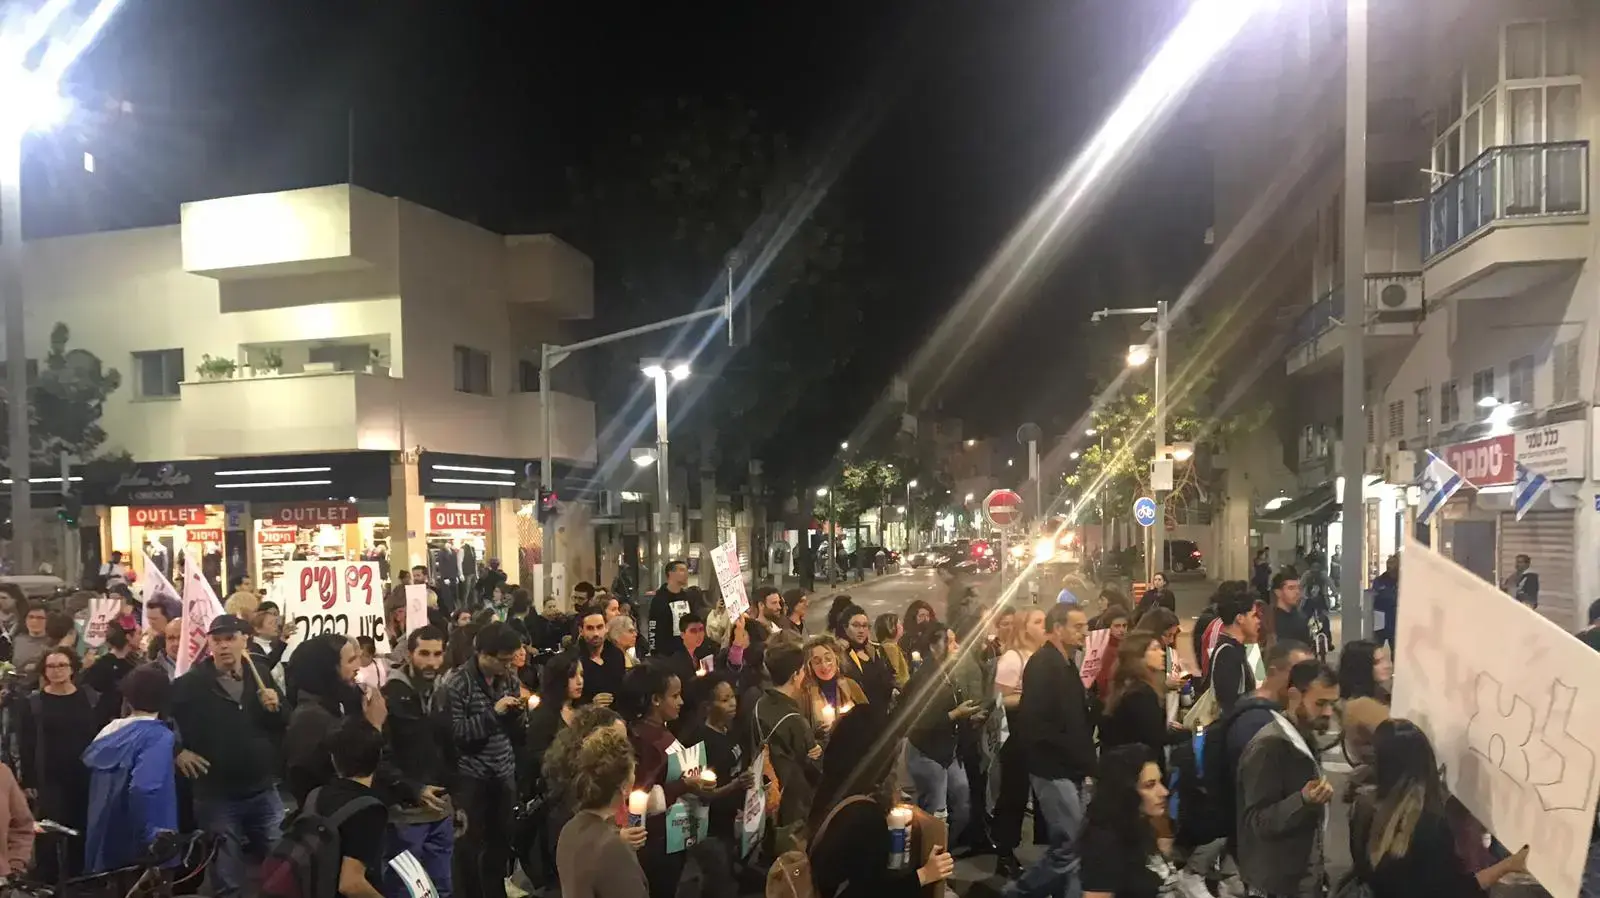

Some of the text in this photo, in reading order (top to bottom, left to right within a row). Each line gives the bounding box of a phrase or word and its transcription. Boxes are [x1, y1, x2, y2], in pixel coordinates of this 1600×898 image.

[1451, 443, 1503, 478] טמבור
[136, 508, 198, 522] OUTLET
[281, 507, 349, 520] OUTLET
[436, 512, 485, 526] OUTLET
[261, 531, 291, 542] חיסול
[300, 565, 373, 610] דם נשים
